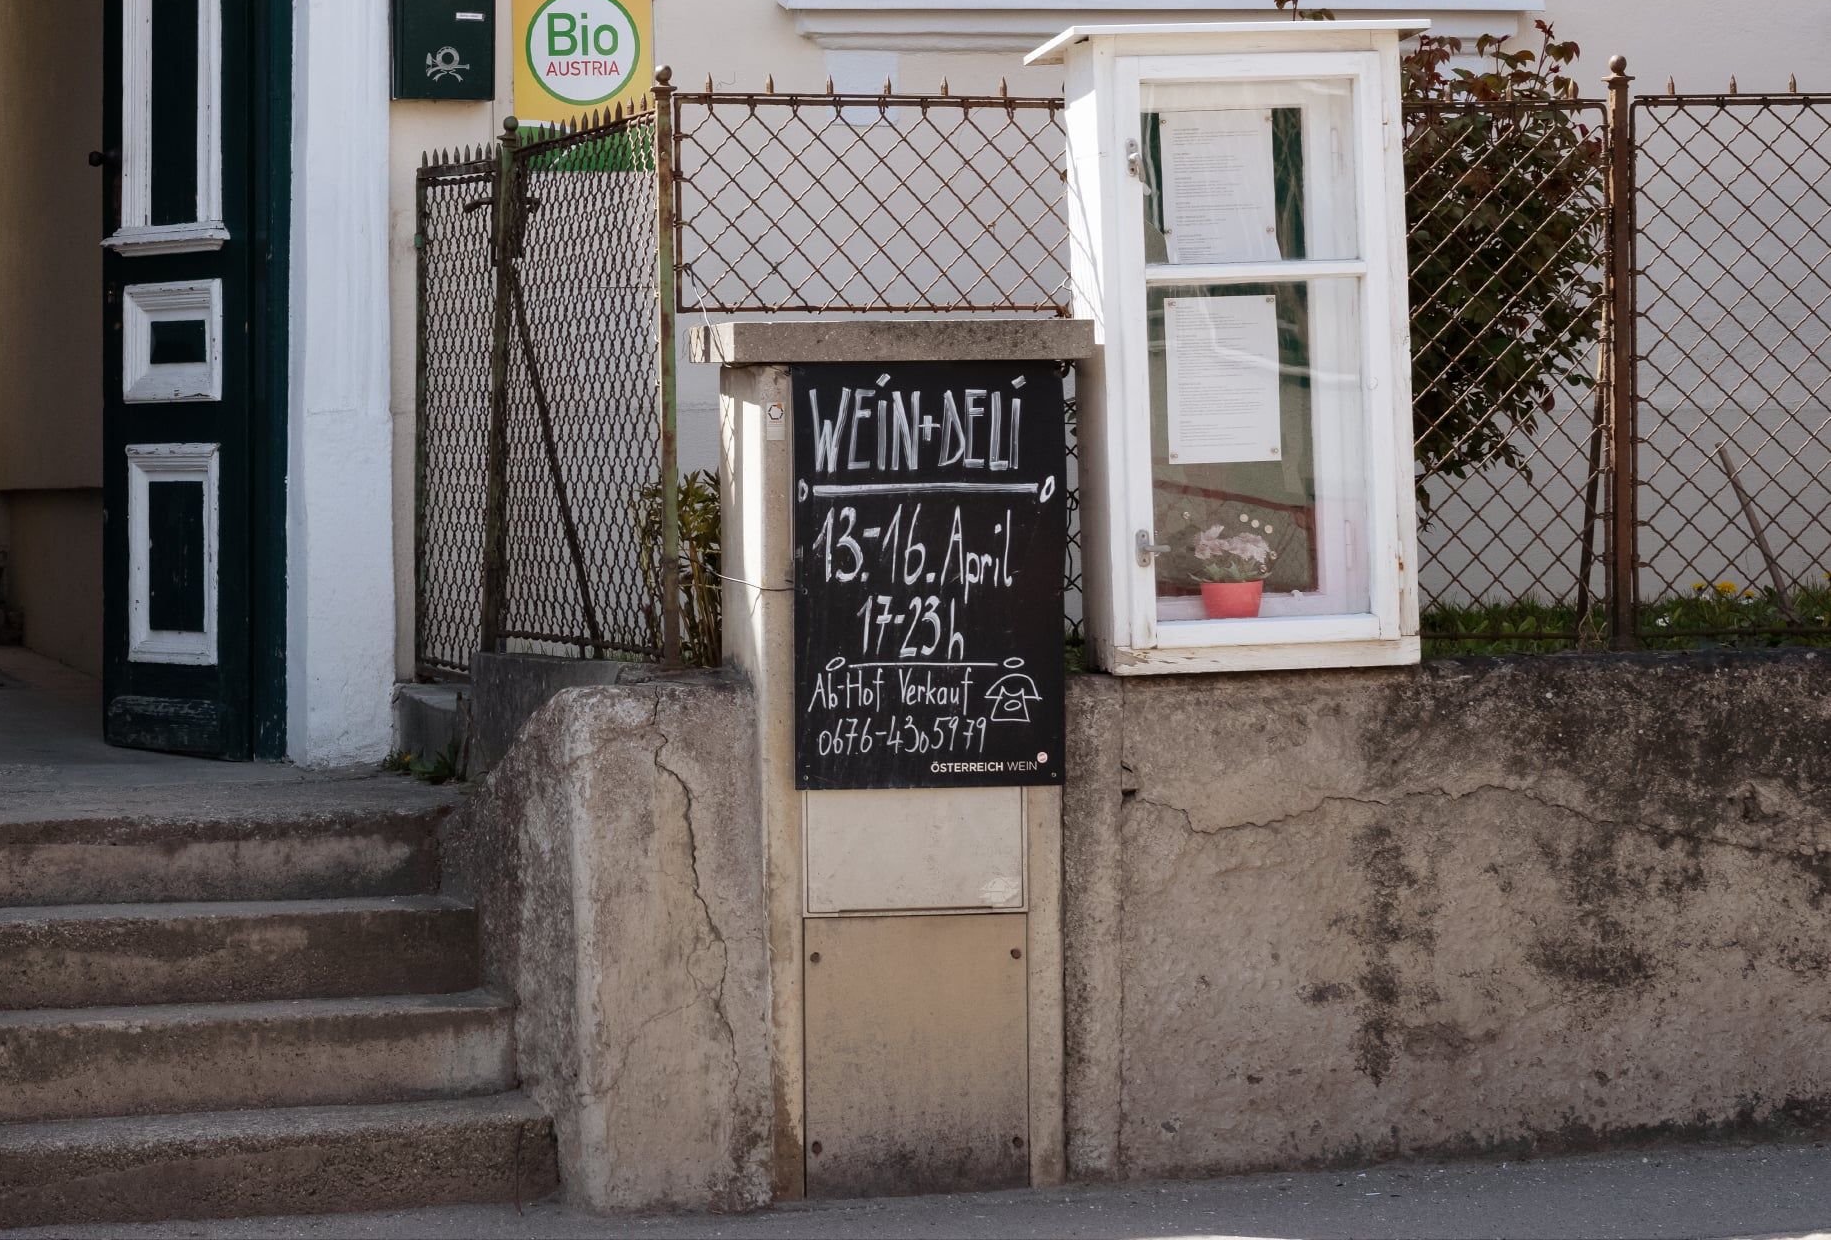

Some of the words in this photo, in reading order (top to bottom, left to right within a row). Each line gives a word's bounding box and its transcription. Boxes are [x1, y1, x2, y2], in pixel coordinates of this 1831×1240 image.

[547, 12, 619, 56] Bio
[545, 60, 621, 76] AUSTRIA
[940, 504, 1013, 604] April
[807, 667, 885, 712] Ab-Hof
[898, 667, 974, 716] Verkauf
[930, 760, 1004, 773] ÖSTERREICH
[1006, 760, 1038, 772] WEIN
